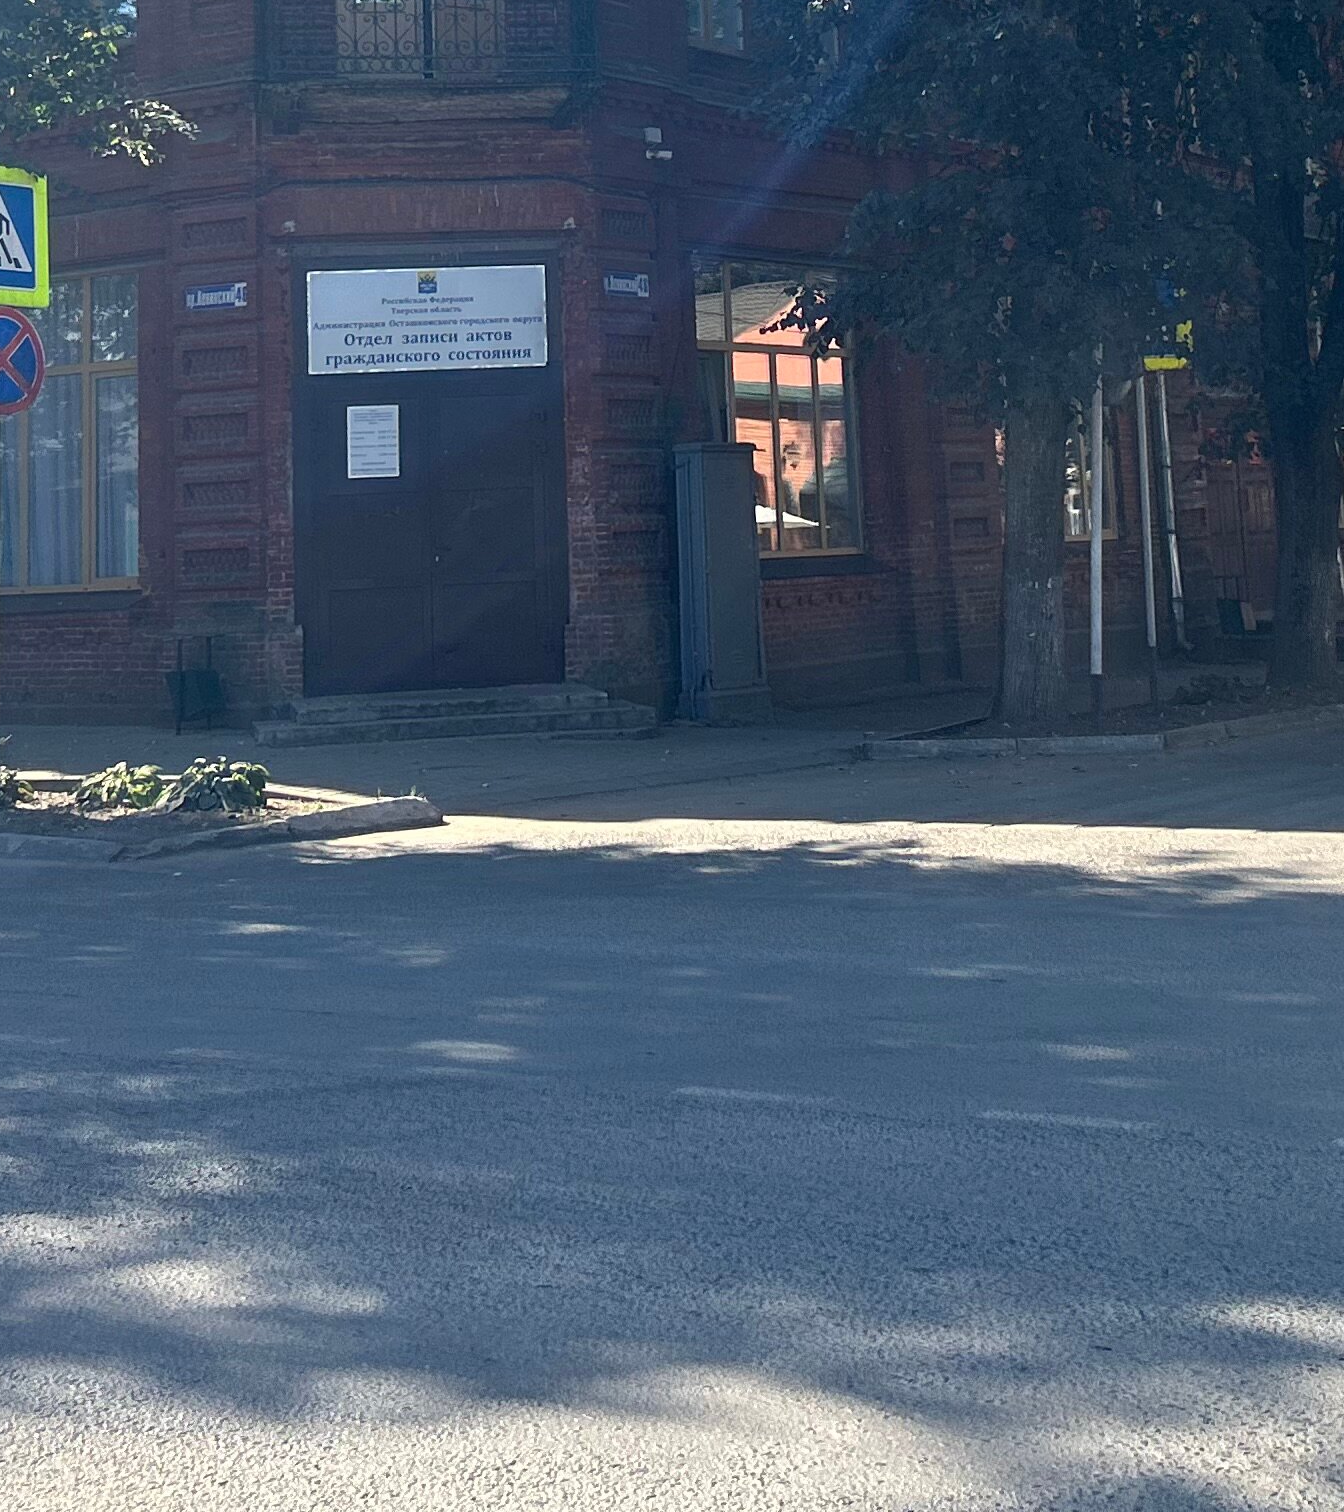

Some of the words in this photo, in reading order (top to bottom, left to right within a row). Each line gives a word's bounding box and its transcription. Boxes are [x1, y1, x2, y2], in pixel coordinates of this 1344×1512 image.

[382, 297, 428, 305] Российская
[429, 296, 474, 304] Федерация
[391, 307, 428, 315] Тверская
[430, 305, 463, 313] область
[313, 321, 386, 330] Администрация
[388, 319, 458, 328] Осташковского
[460, 316, 510, 326] городского
[512, 315, 543, 325] округа
[344, 333, 393, 348] Отдел
[401, 332, 458, 345] записи
[466, 331, 512, 342] актов
[325, 352, 441, 369] гражданского
[448, 348, 532, 360] состояния
